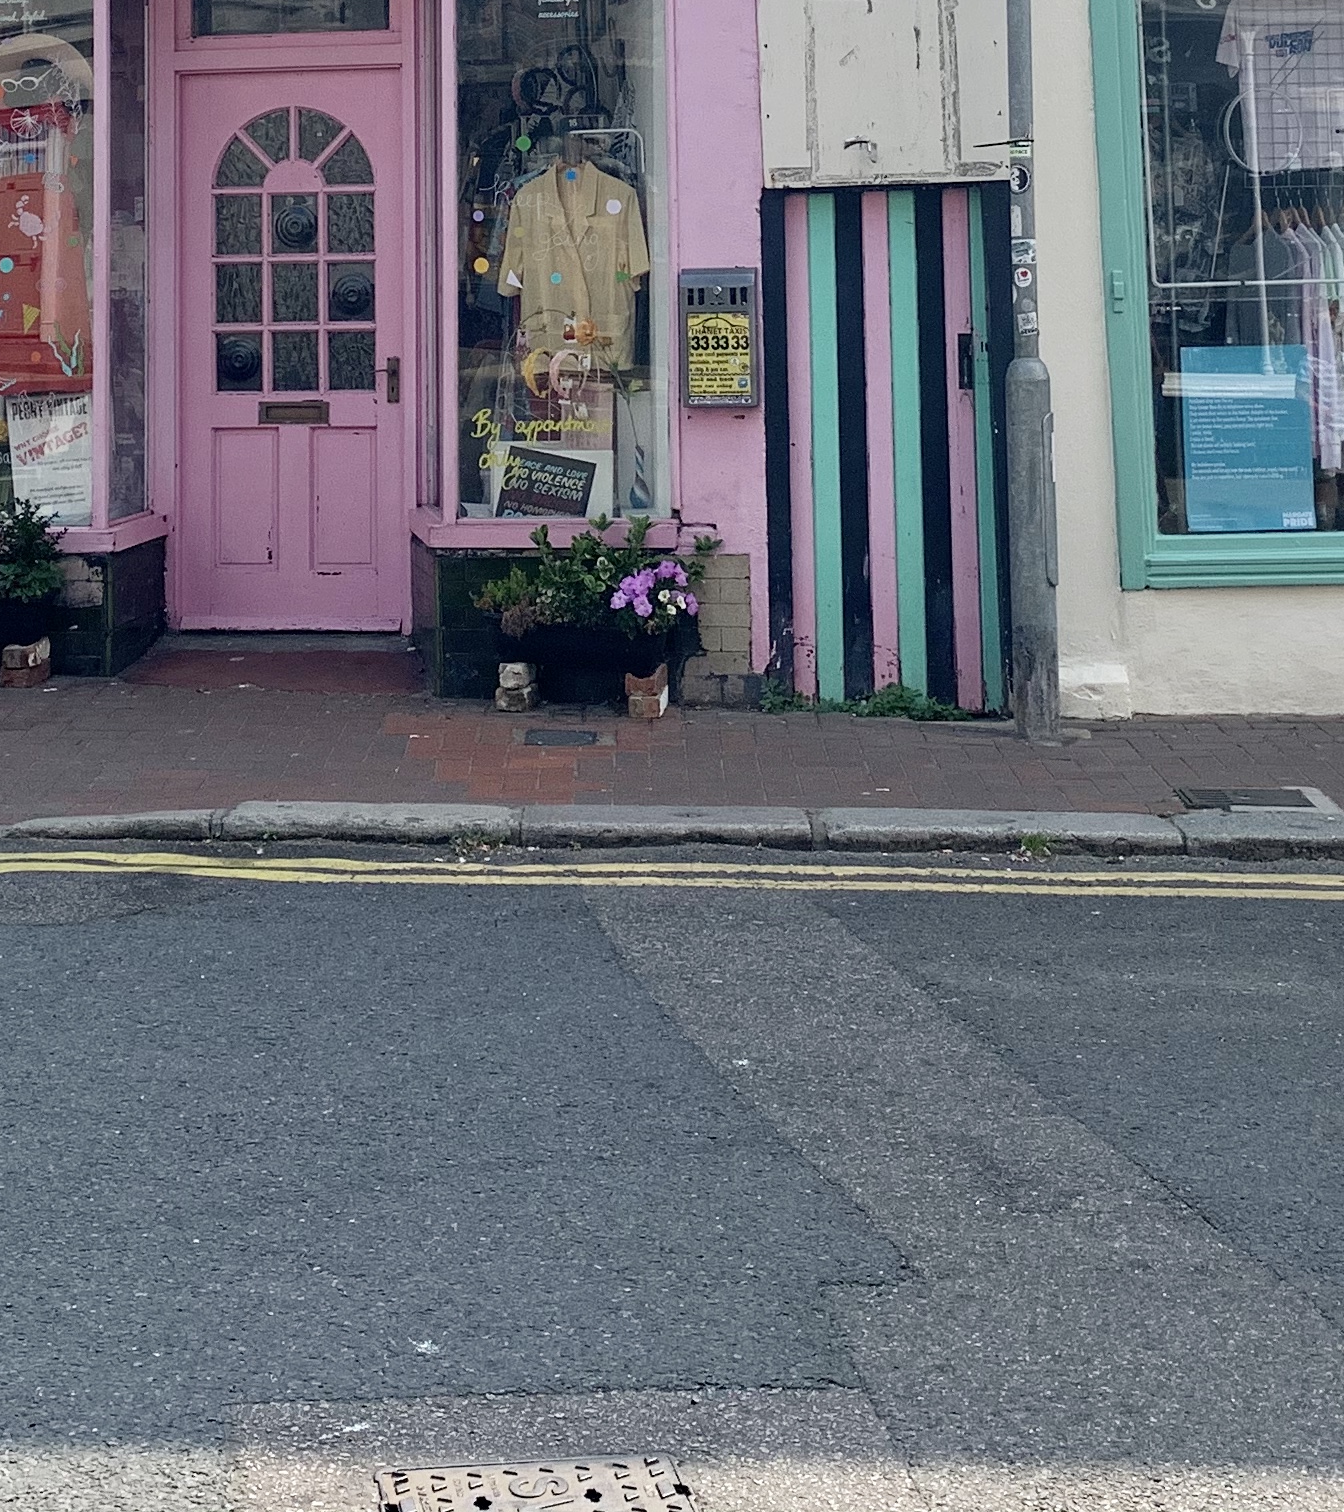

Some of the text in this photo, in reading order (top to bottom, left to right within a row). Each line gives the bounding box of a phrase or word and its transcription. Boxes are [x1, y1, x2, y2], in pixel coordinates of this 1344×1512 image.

[724, 327, 748, 335] TAXIS
[470, 408, 502, 450] By
[517, 458, 543, 471] EACE
[543, 463, 564, 475] AND
[531, 470, 587, 491] VIOLENCE
[533, 482, 584, 502] SEXISM
[1282, 518, 1315, 528] PRIDE
